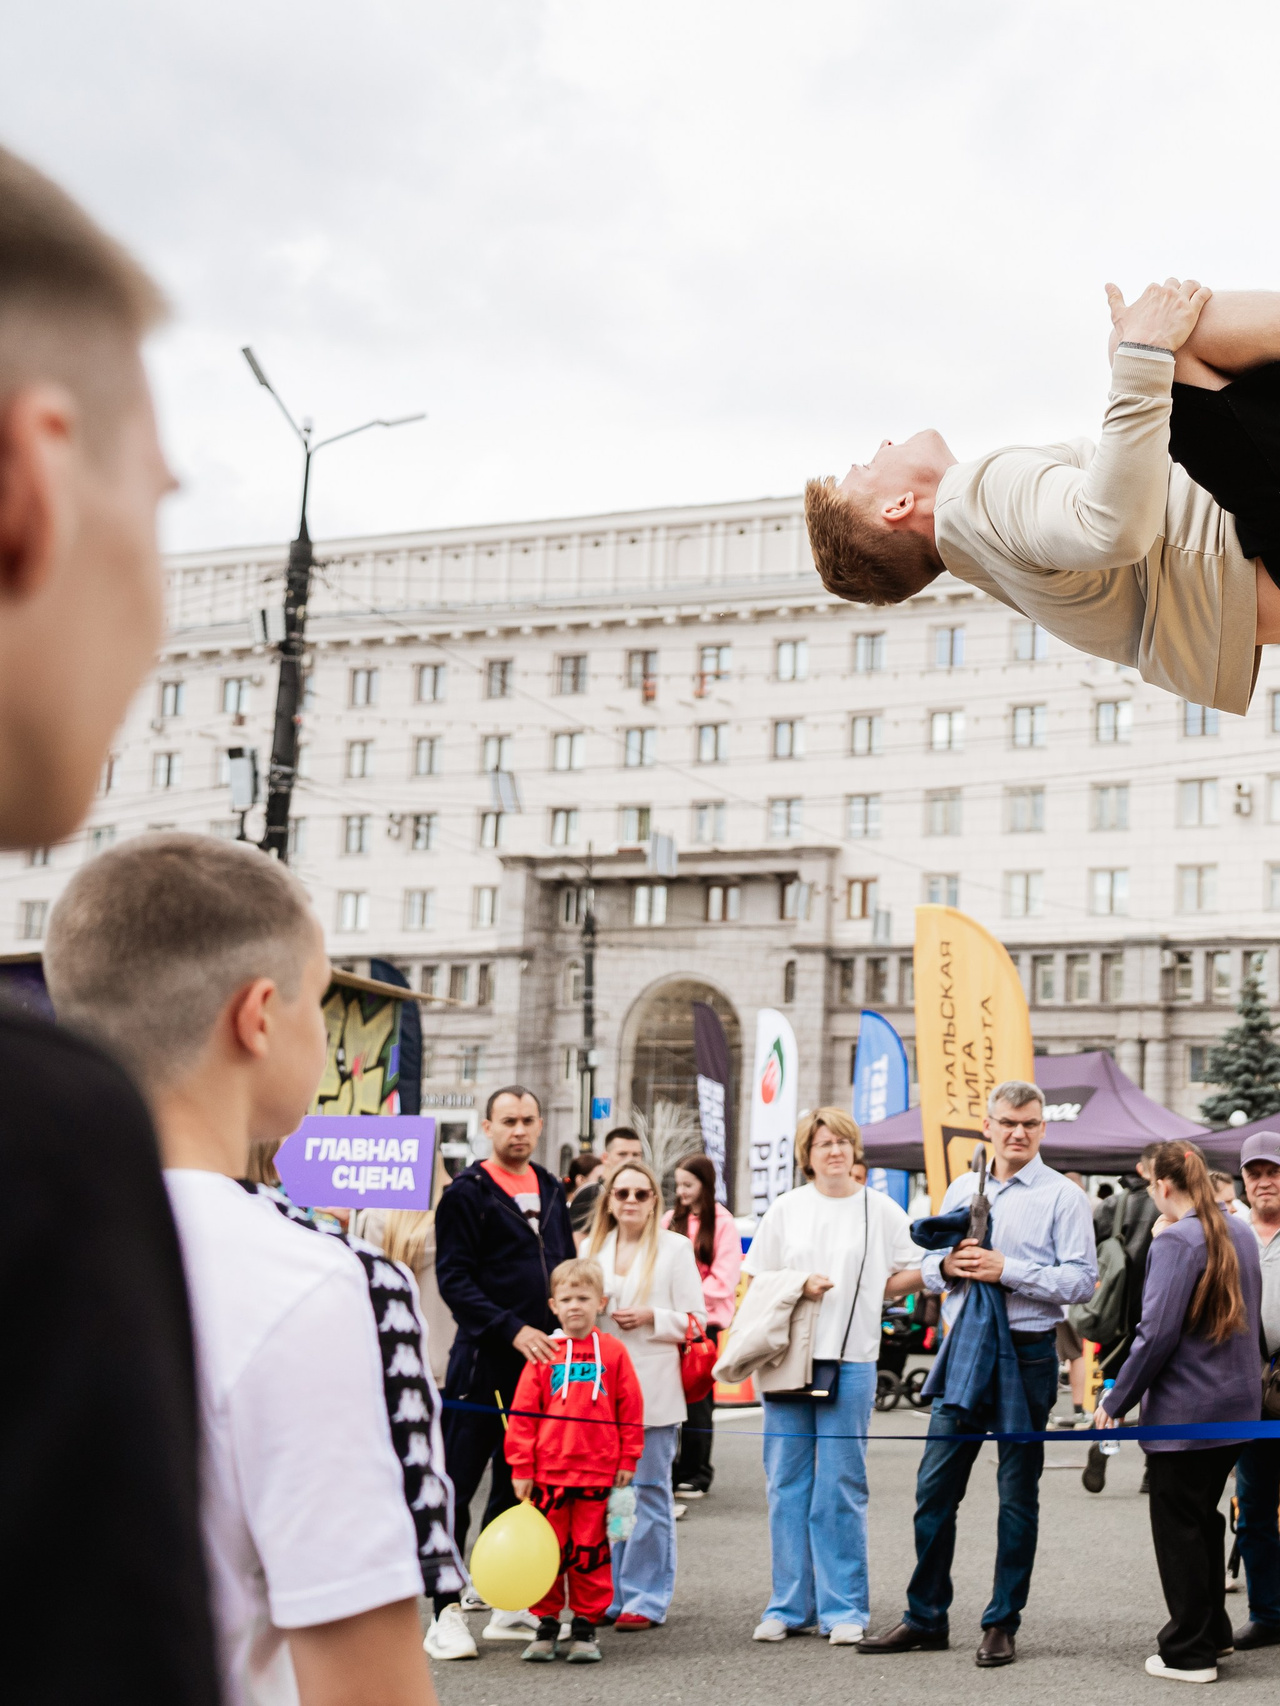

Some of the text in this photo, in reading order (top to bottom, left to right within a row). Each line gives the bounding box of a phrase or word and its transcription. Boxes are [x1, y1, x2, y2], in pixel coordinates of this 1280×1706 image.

[938, 940, 961, 1117] УРАЛЬСКАЯ
[962, 1041, 982, 1119] ЛИГА
[304, 1137, 420, 1163] ГЛАВНАЯ
[331, 1165, 416, 1195] СЦЕНА
